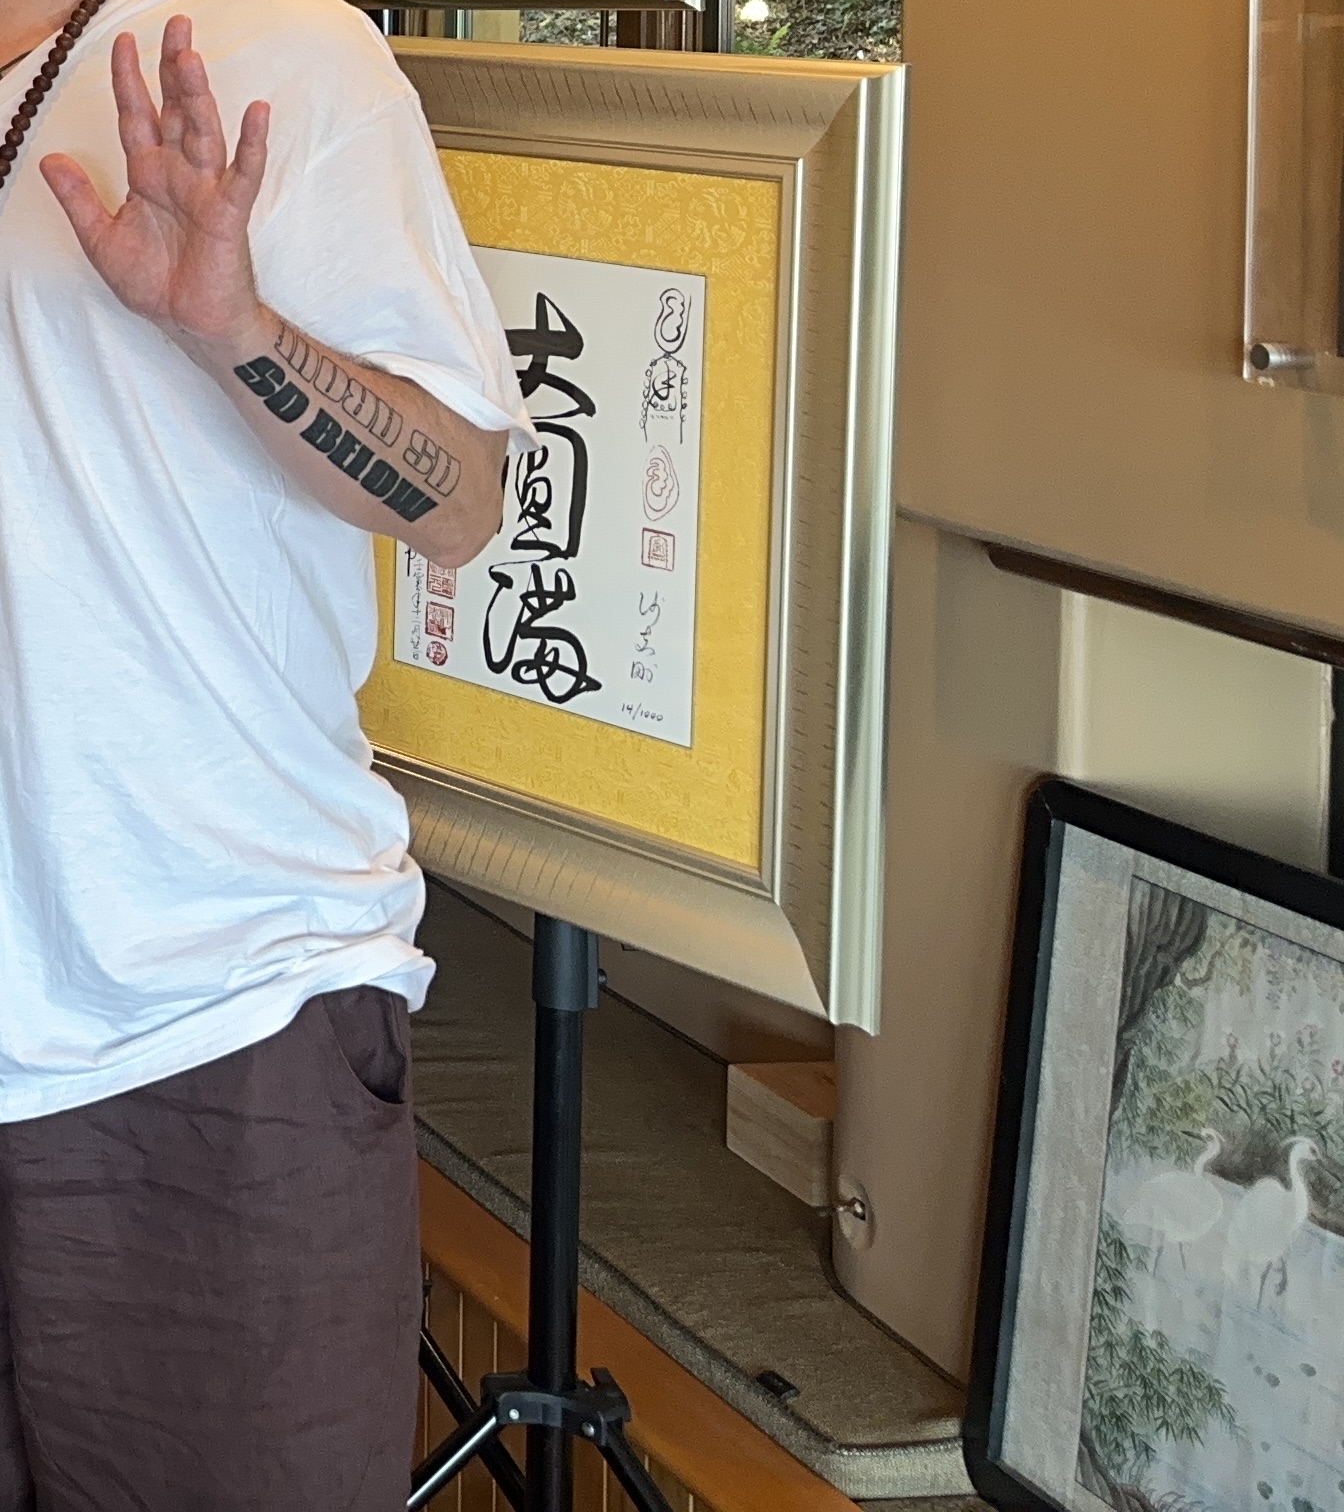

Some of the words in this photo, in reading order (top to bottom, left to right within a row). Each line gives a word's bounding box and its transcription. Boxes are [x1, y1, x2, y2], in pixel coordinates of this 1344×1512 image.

[233, 355, 310, 424] SO
[299, 407, 440, 523] BELOW
[621, 702, 664, 722] 14/1000
